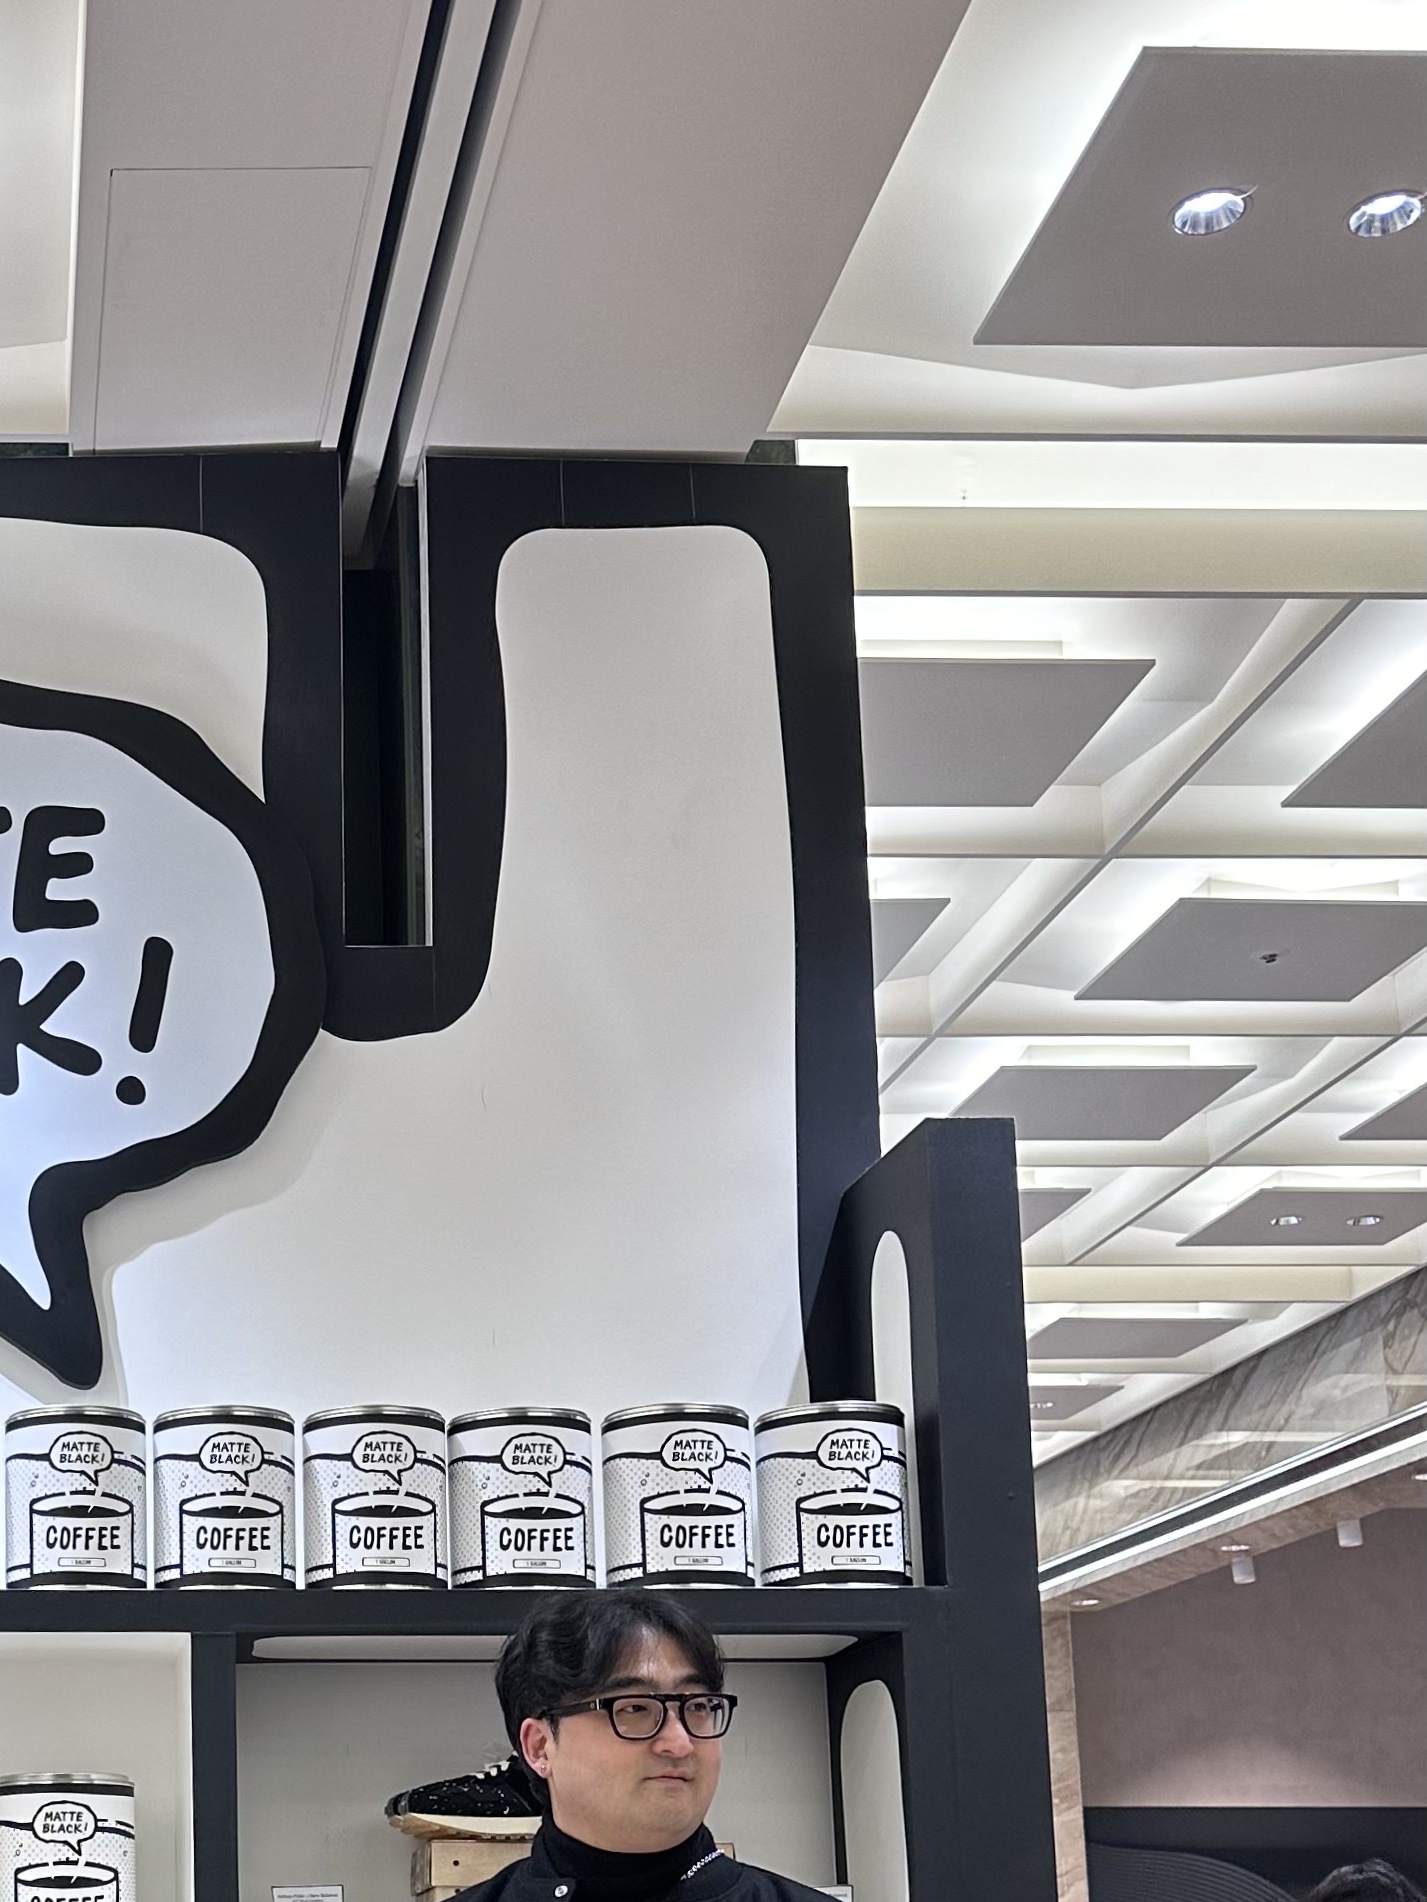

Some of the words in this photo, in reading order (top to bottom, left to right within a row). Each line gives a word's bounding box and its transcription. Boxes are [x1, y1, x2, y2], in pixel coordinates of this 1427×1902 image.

[61, 1442, 100, 1452] MATTE
[211, 1442, 251, 1453] MATTE
[364, 1441, 403, 1452] MATTE
[513, 1443, 553, 1454] MATTE
[673, 1439, 713, 1450] MATTE
[830, 1439, 870, 1449] MATTE
[59, 1453, 105, 1464] BLACK!
[210, 1453, 255, 1465] BLACK!
[362, 1453, 408, 1464] BLACK!
[512, 1455, 557, 1465] BLACK!
[672, 1451, 718, 1462] BLACK!
[828, 1451, 875, 1461] BLACK!
[46, 1525, 121, 1551] COFFEE
[196, 1526, 271, 1551] COFFEE
[349, 1525, 424, 1550] COFFEE
[499, 1527, 574, 1552] COFFEE
[660, 1524, 735, 1549] COFFEE
[817, 1523, 893, 1548] COFFEE
[44, 1811, 83, 1822] MATTE
[42, 1823, 88, 1834] BLACK!
